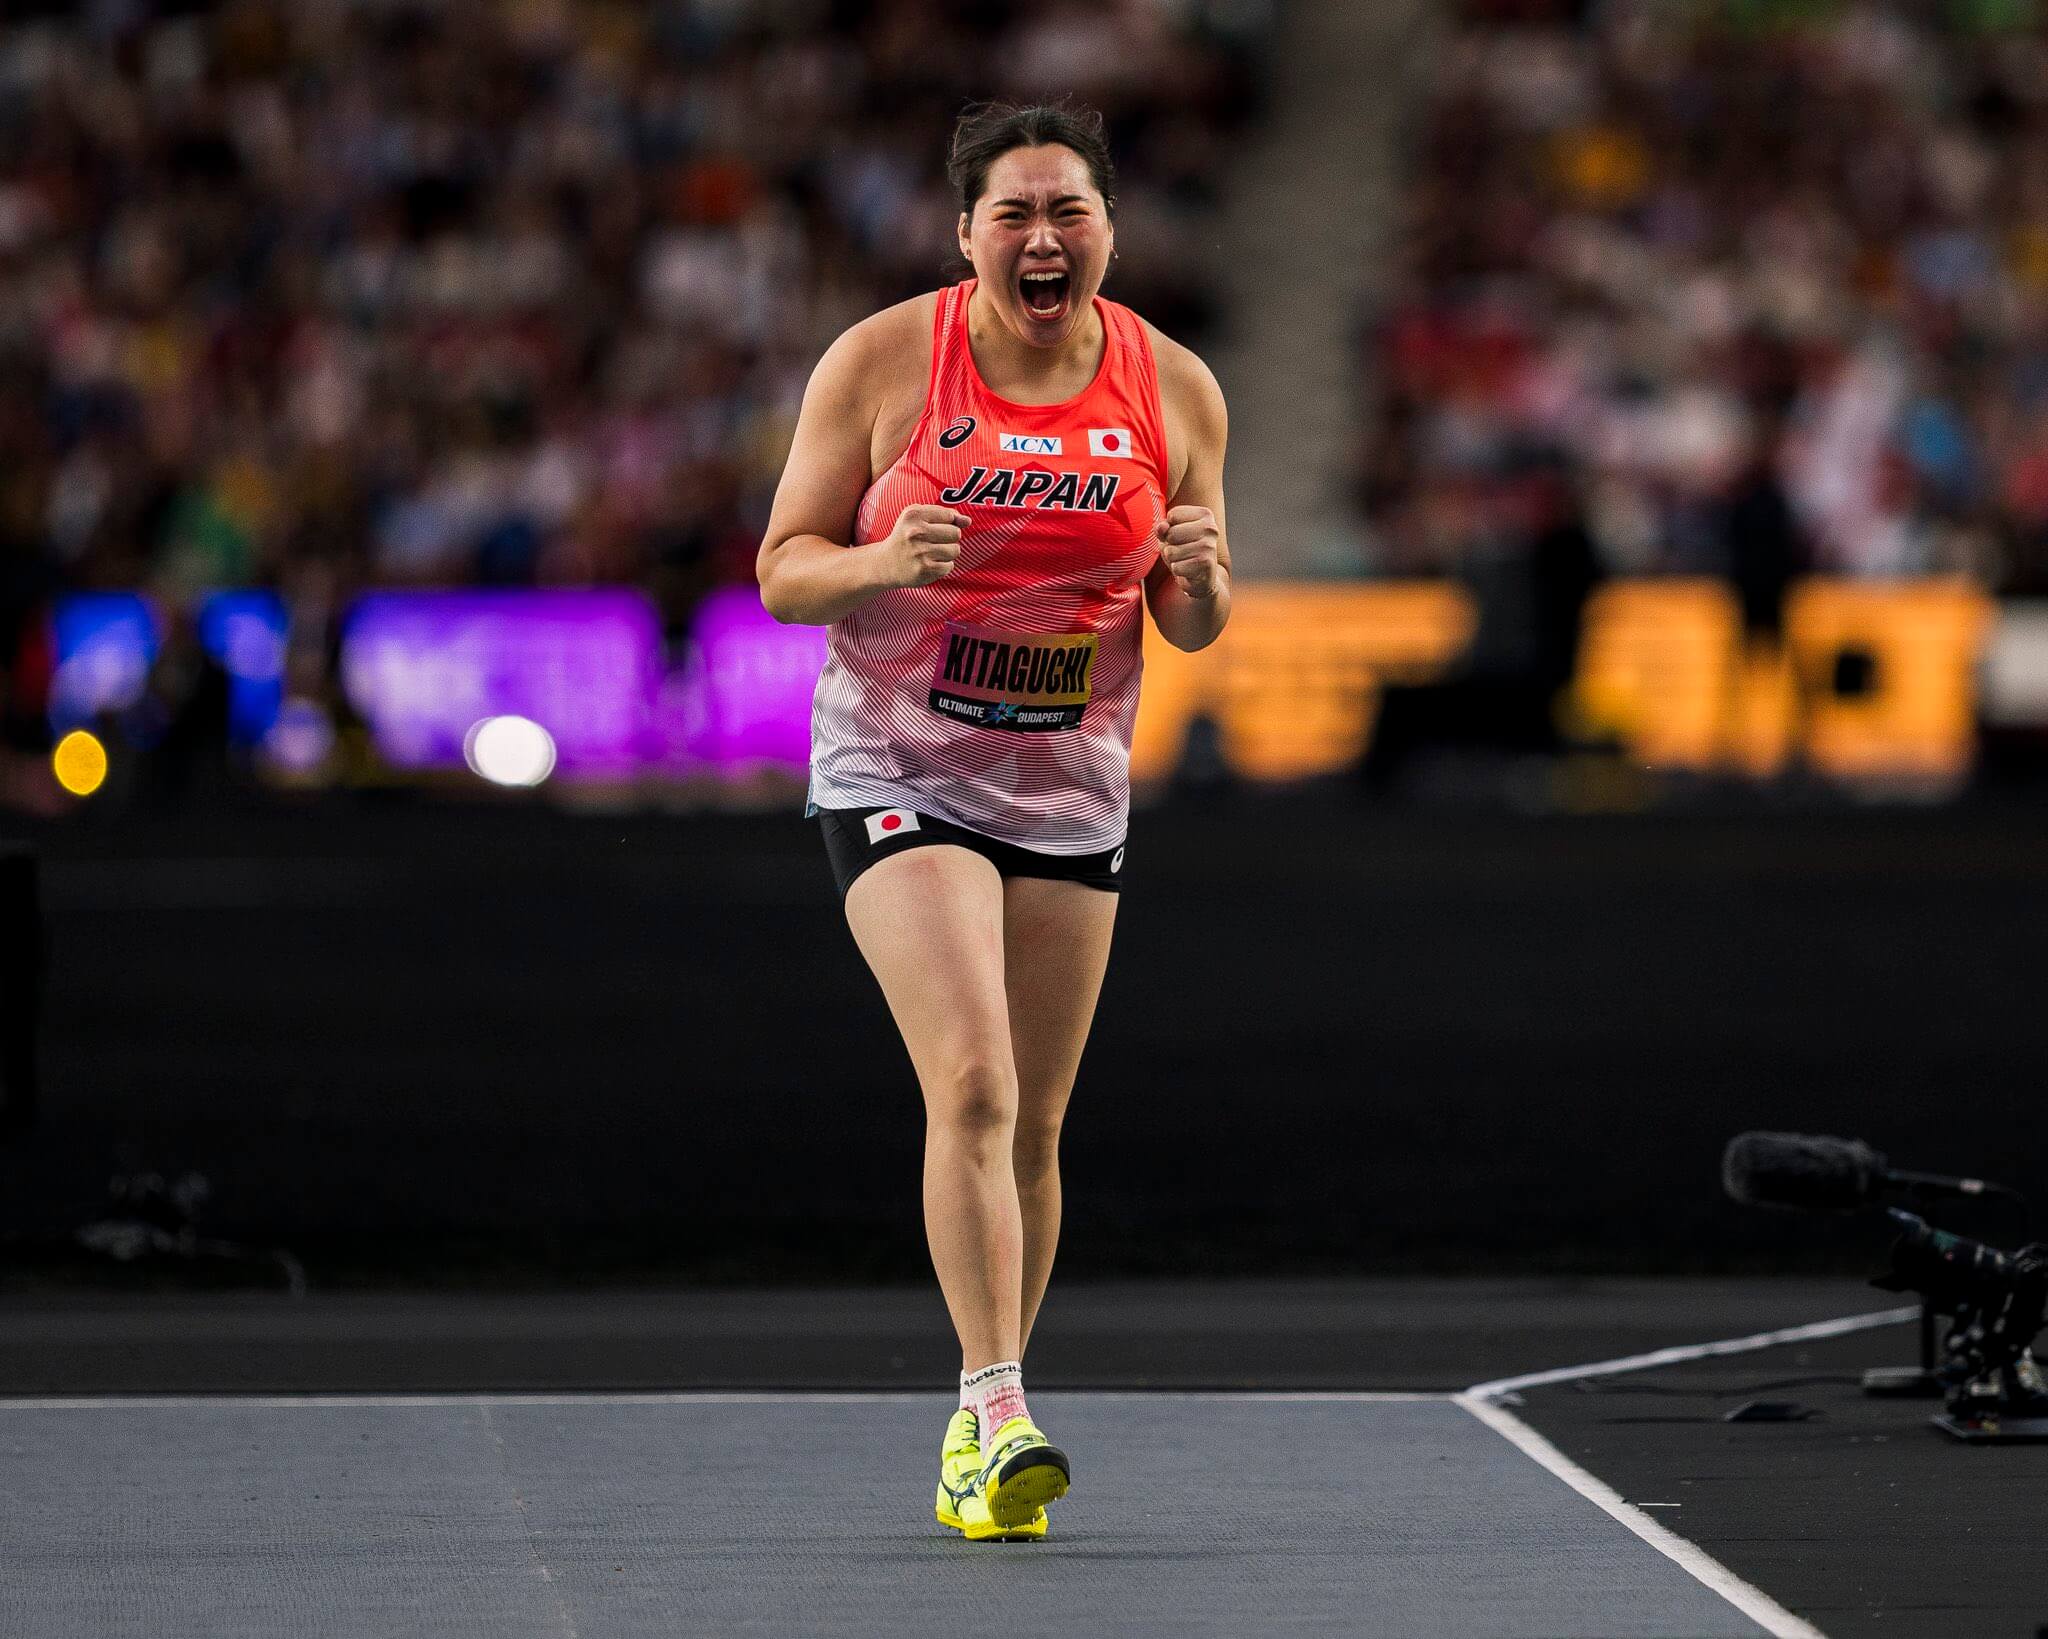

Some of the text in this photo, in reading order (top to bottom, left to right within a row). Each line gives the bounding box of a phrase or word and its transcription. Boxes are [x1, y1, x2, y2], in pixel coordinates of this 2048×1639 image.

[1003, 436, 1059, 453] ACN
[941, 466, 1120, 513] JAPAN
[943, 634, 1092, 695] KITAGUCHI
[938, 697, 985, 718] ULTIMATE
[1017, 711, 1065, 724] BUDAPEST
